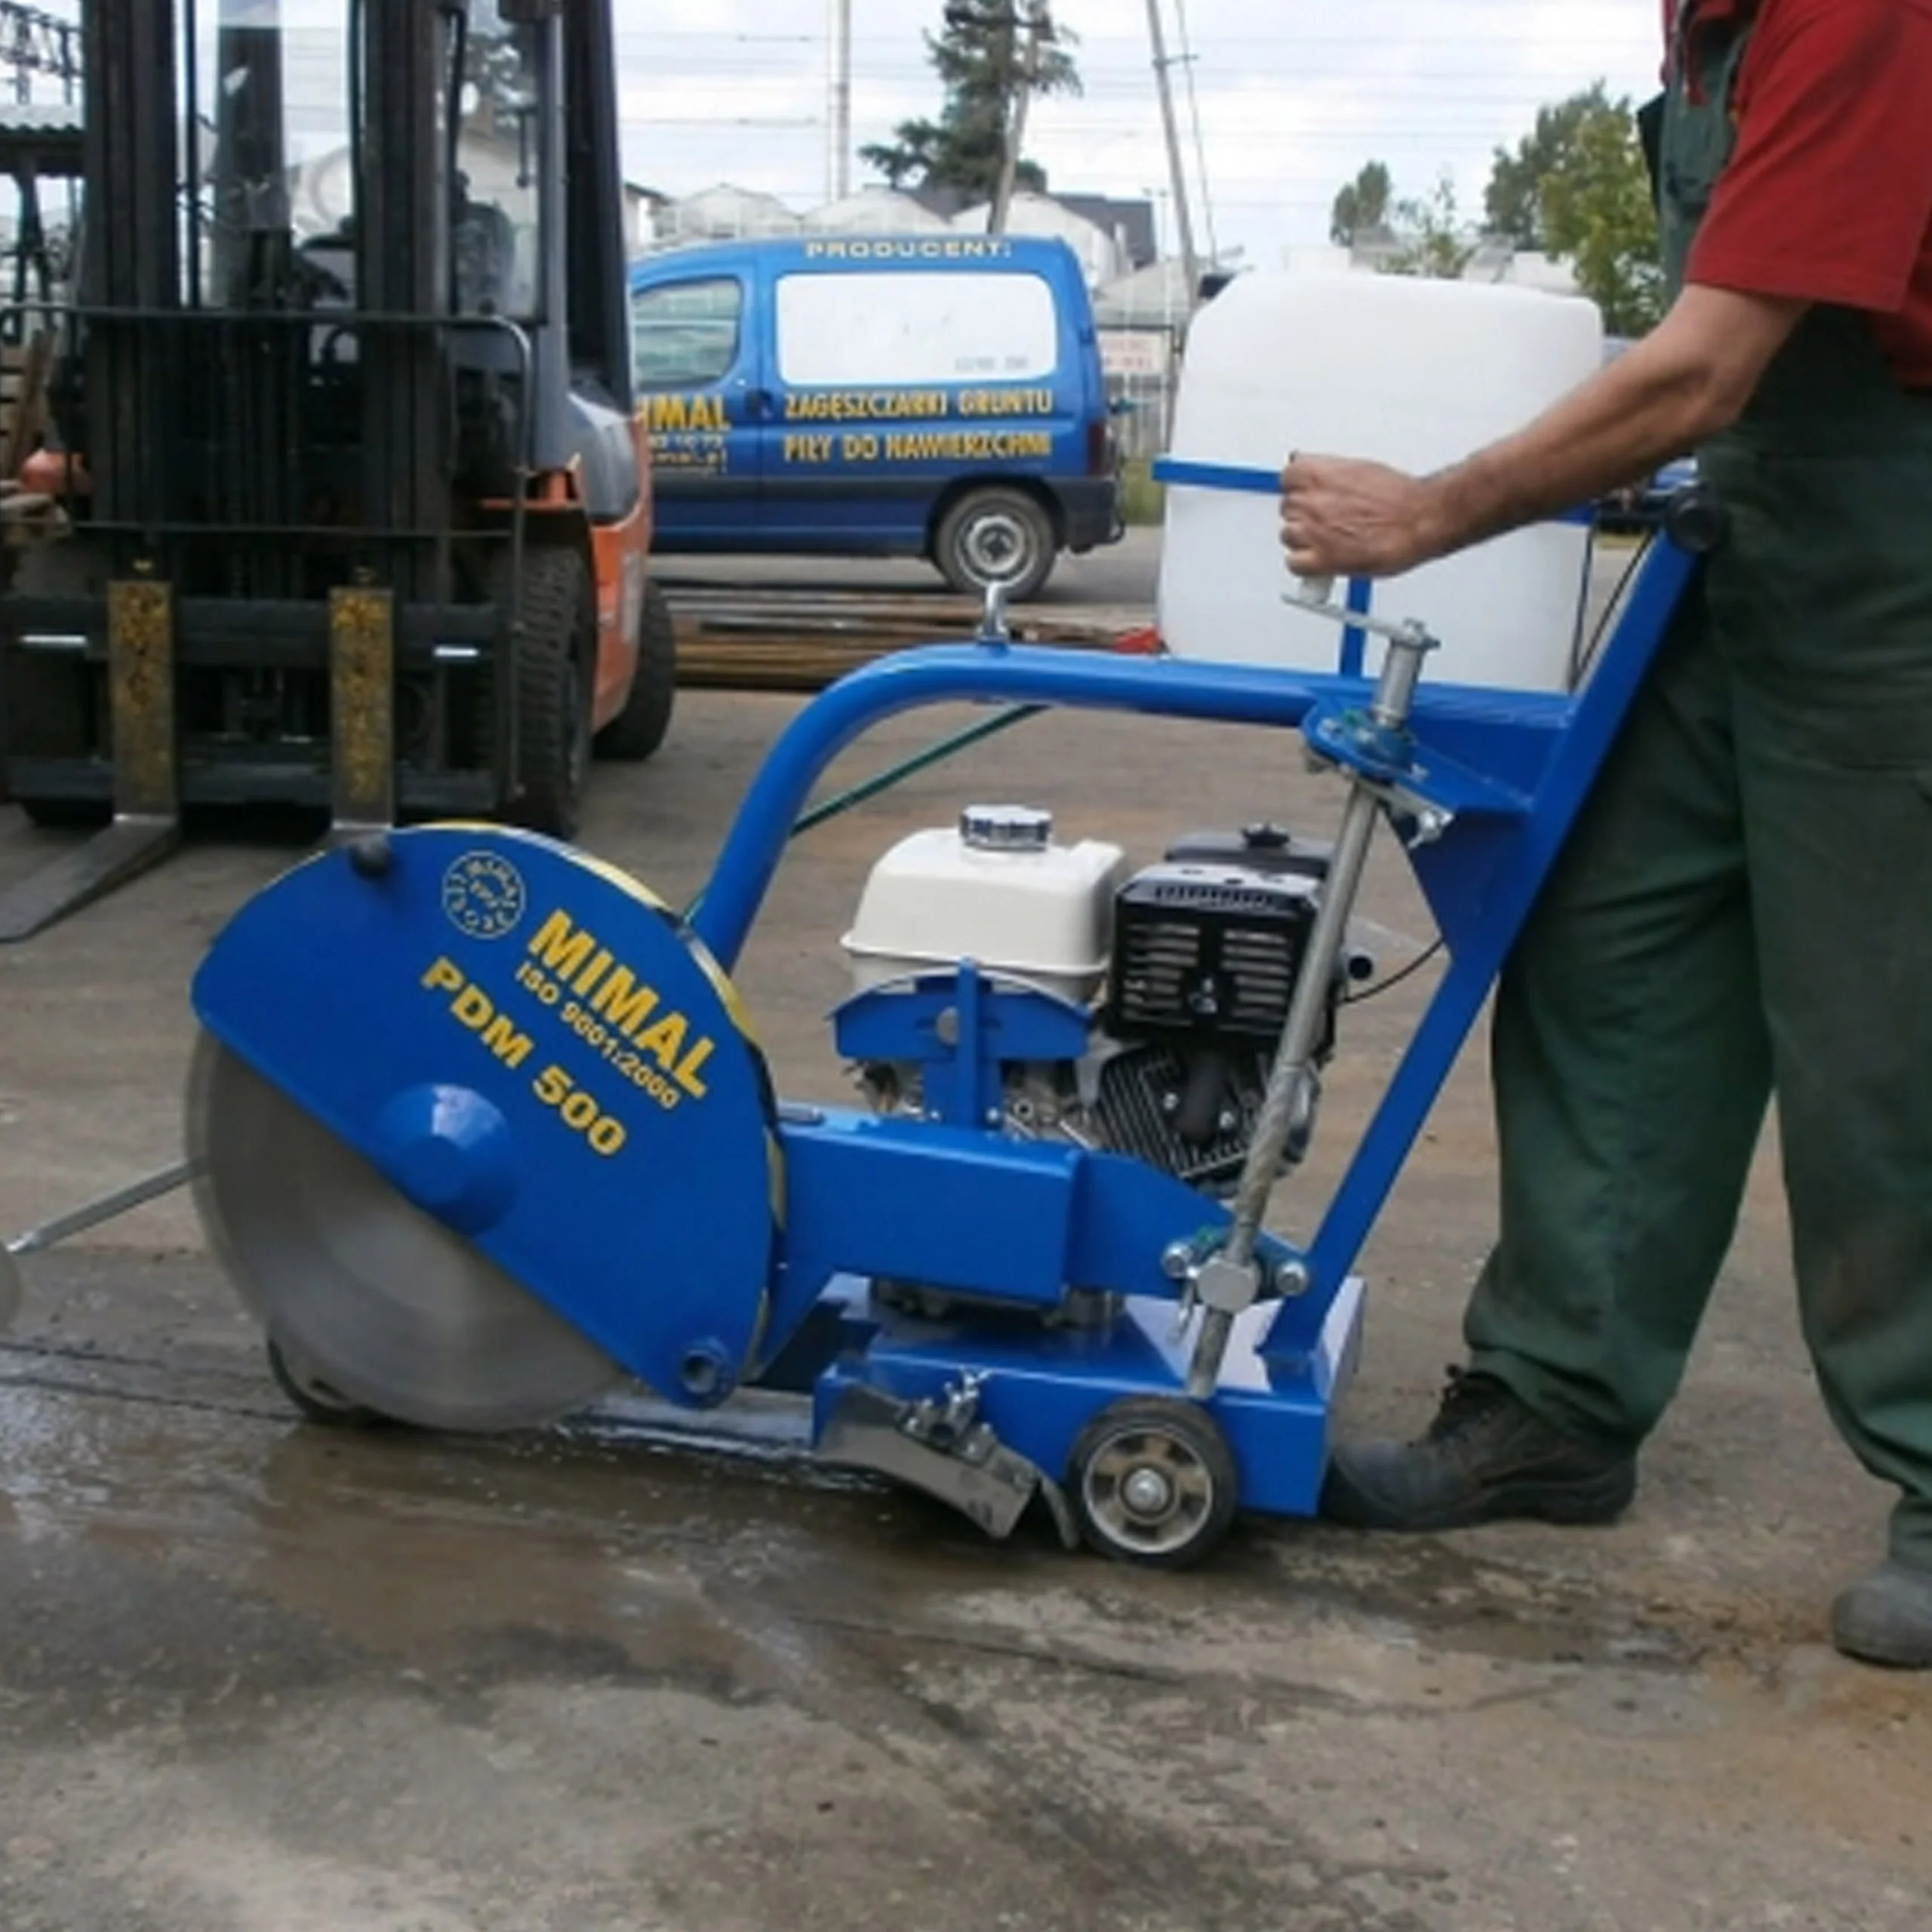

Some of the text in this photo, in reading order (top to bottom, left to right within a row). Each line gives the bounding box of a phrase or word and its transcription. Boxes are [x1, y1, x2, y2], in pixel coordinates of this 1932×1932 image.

[806, 241, 1012, 258] PRODUCENT:
[638, 393, 732, 431] IMAL
[958, 389, 1052, 414] GRUNTU
[841, 433, 878, 460] DO
[528, 908, 715, 1099] MIMAL
[515, 961, 679, 1109] ISO 9001:2000
[421, 956, 627, 1155] PDM 500
